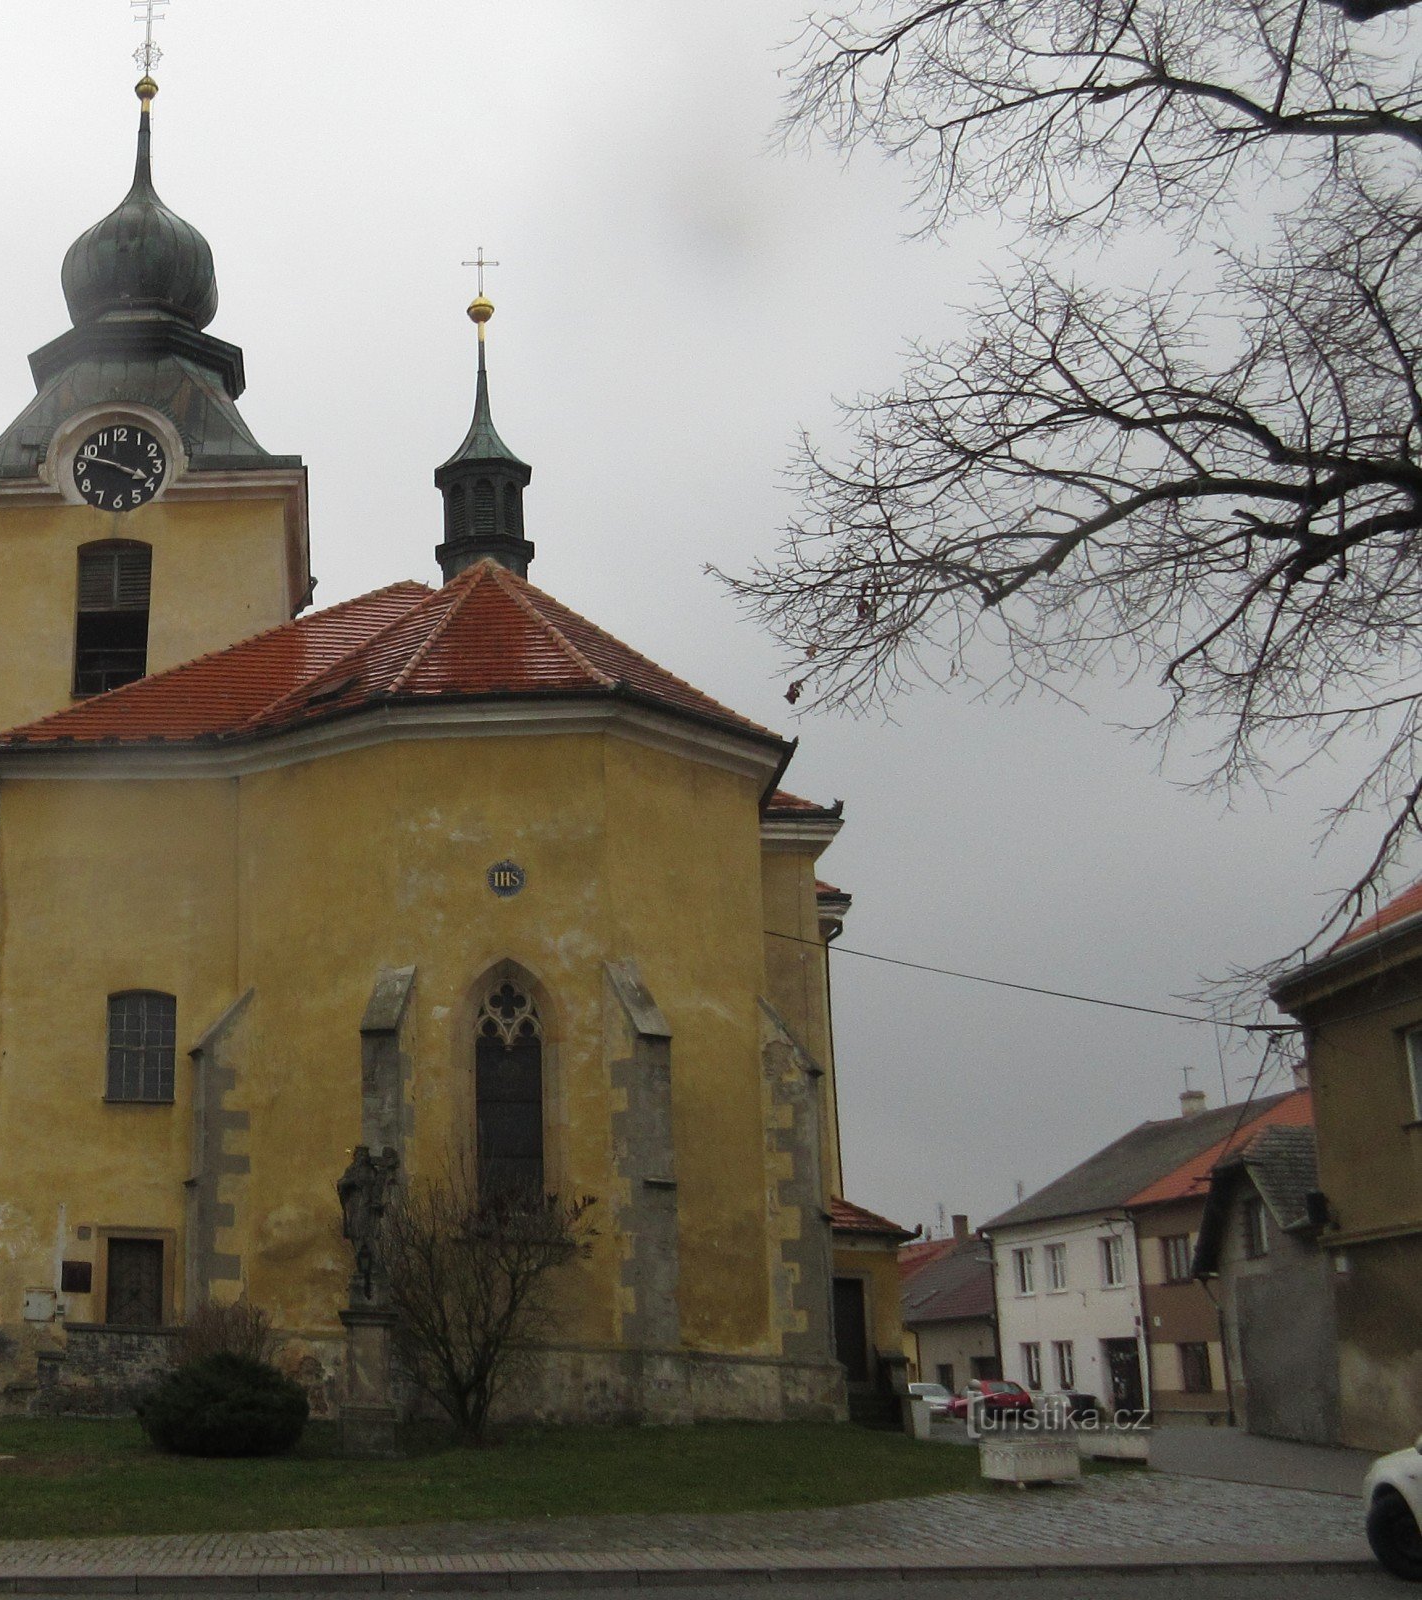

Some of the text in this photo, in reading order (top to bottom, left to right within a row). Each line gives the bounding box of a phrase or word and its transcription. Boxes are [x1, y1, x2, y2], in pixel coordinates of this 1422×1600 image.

[98, 432, 108, 446] 11
[113, 428, 128, 442] 12
[137, 432, 142, 446] 1
[84, 444, 98, 458] 10
[147, 443, 158, 457] 2
[77, 461, 87, 475] 9
[152, 459, 163, 474] 3
[81, 479, 92, 493] 8
[144, 477, 155, 491] 4
[95, 491, 105, 504] 7
[113, 494, 123, 509] 6
[131, 489, 142, 504] 5
[494, 871, 520, 887] IHS
